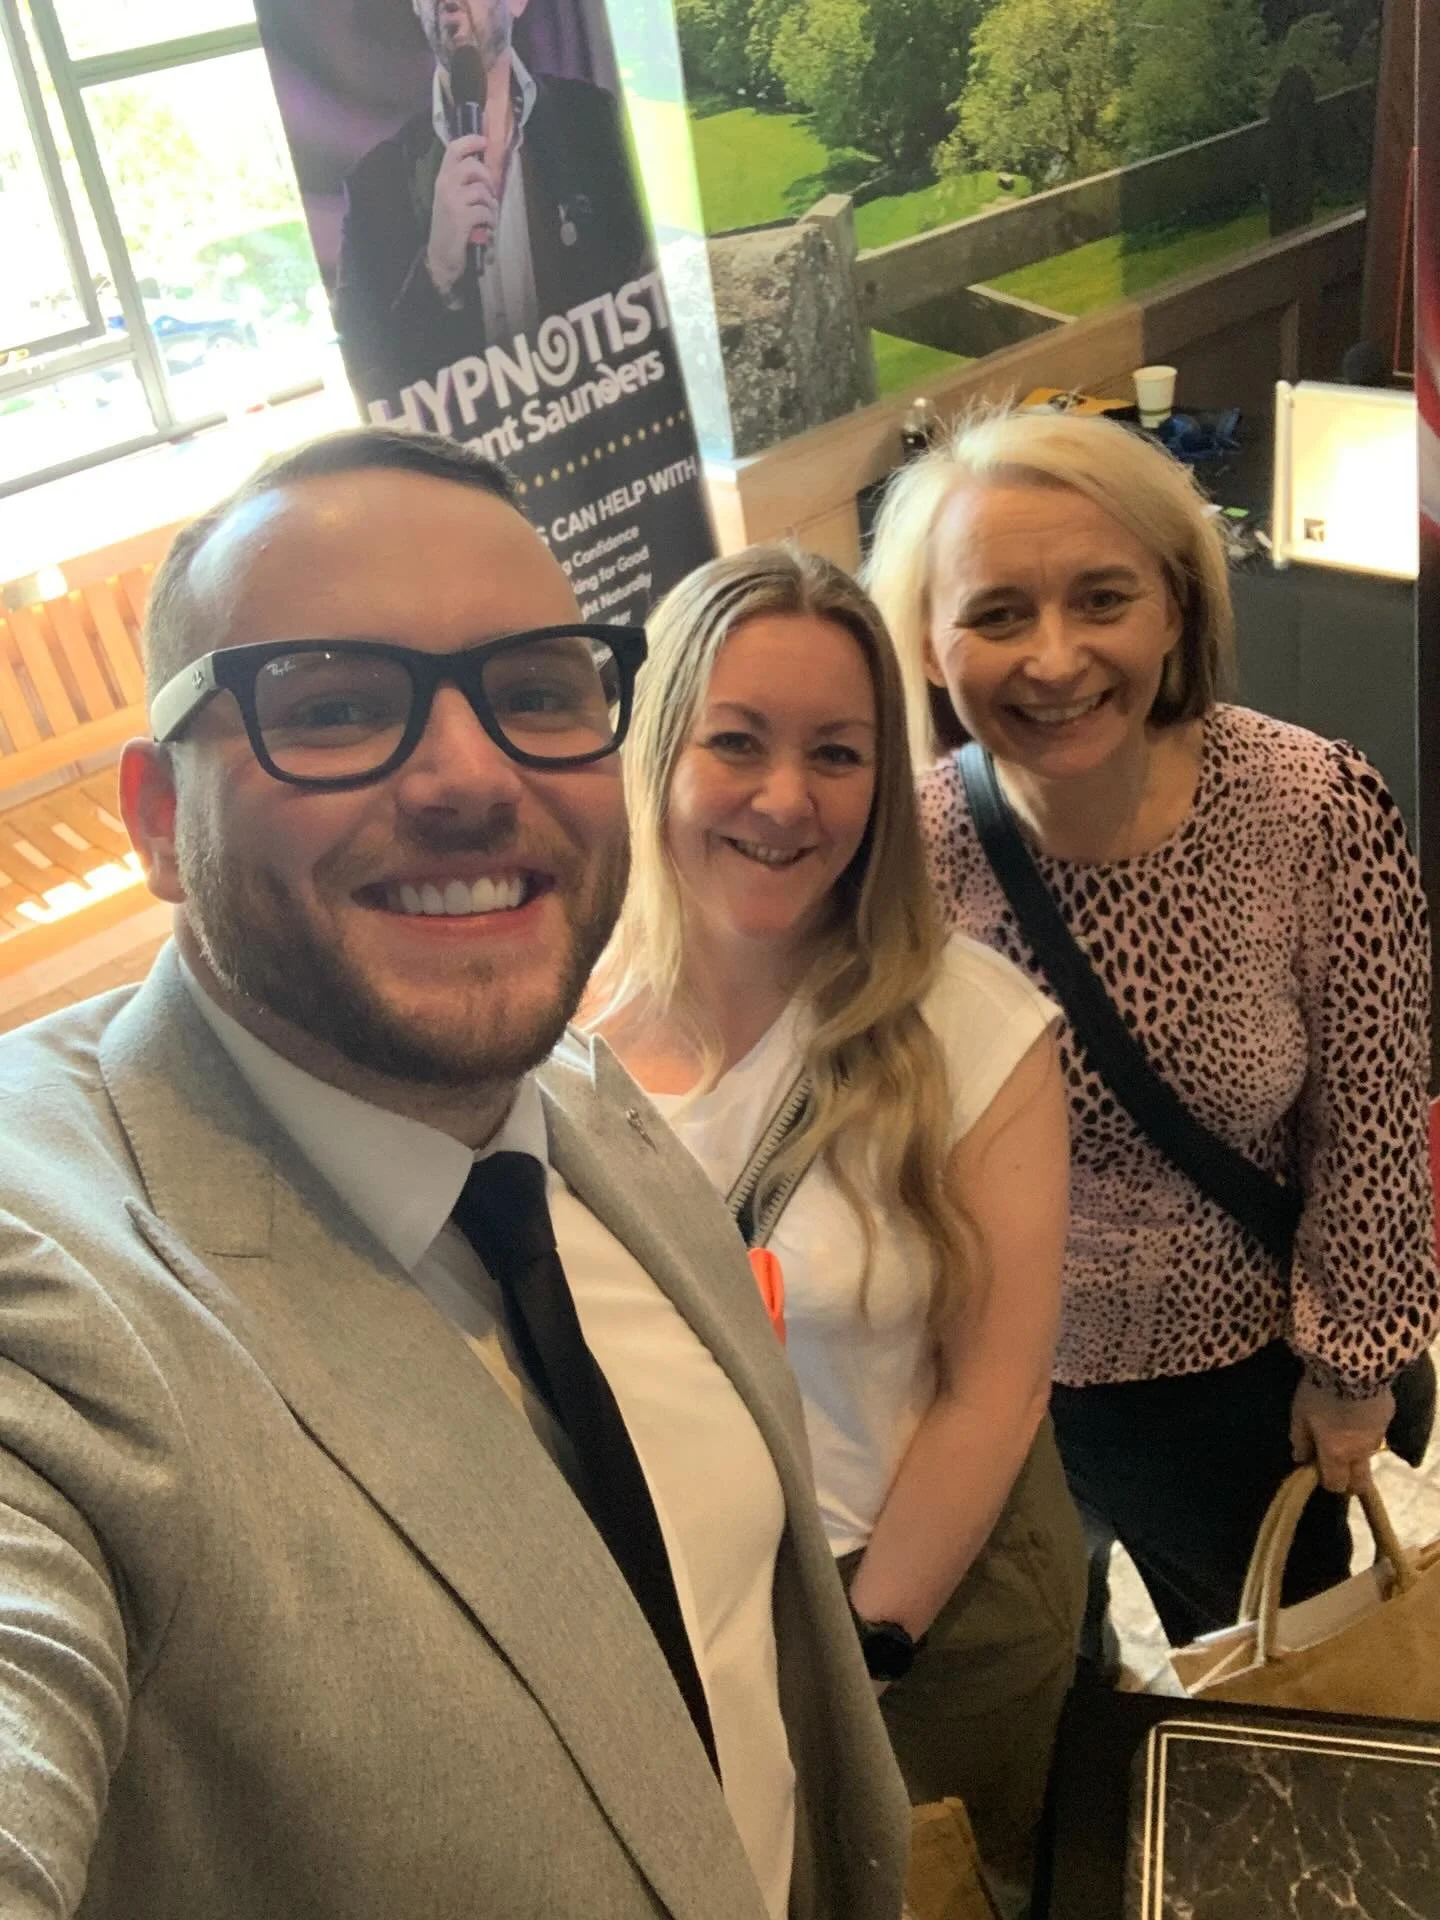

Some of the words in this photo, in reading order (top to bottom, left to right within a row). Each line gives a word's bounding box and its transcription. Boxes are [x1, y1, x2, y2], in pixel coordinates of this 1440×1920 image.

[368, 271, 668, 437] HYPNOTIST
[521, 350, 665, 443] Saunders
[551, 504, 597, 541] CAN
[598, 480, 647, 520] HELP
[648, 456, 698, 494] WITH
[572, 525, 640, 567] Confidence
[598, 565, 617, 583] for
[616, 545, 649, 572] Good
[600, 573, 652, 609] Naturally
